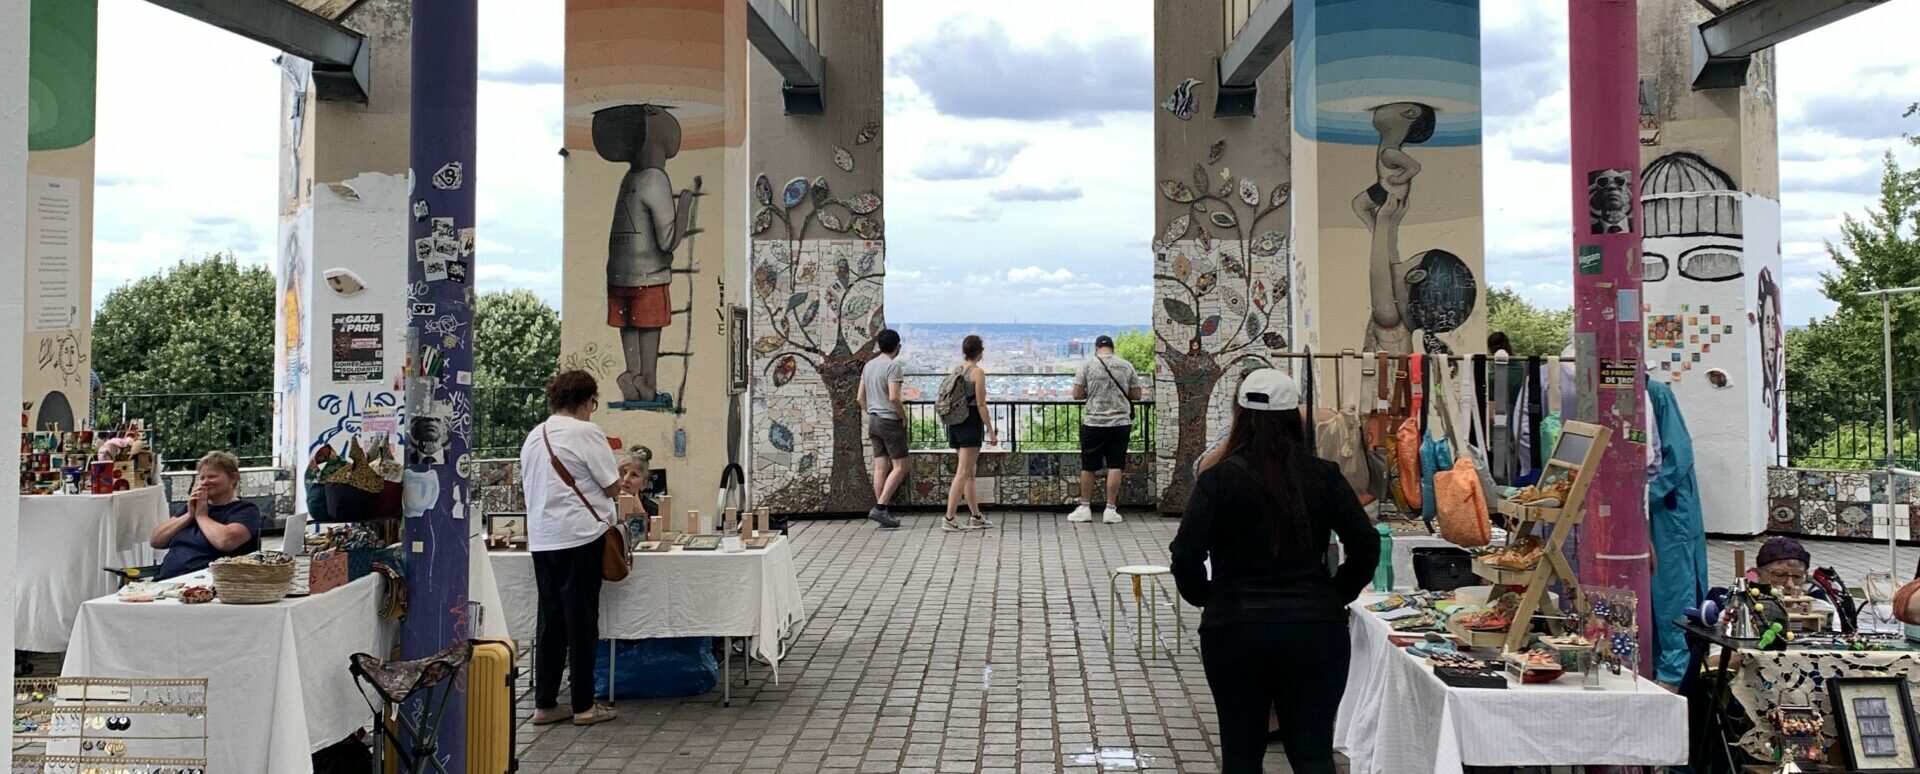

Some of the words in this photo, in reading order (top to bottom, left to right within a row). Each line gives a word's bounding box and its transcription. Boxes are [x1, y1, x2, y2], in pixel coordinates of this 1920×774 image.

[414, 304, 434, 315] SPC
[345, 315, 376, 324] GAZA
[346, 323, 381, 333] PARIS
